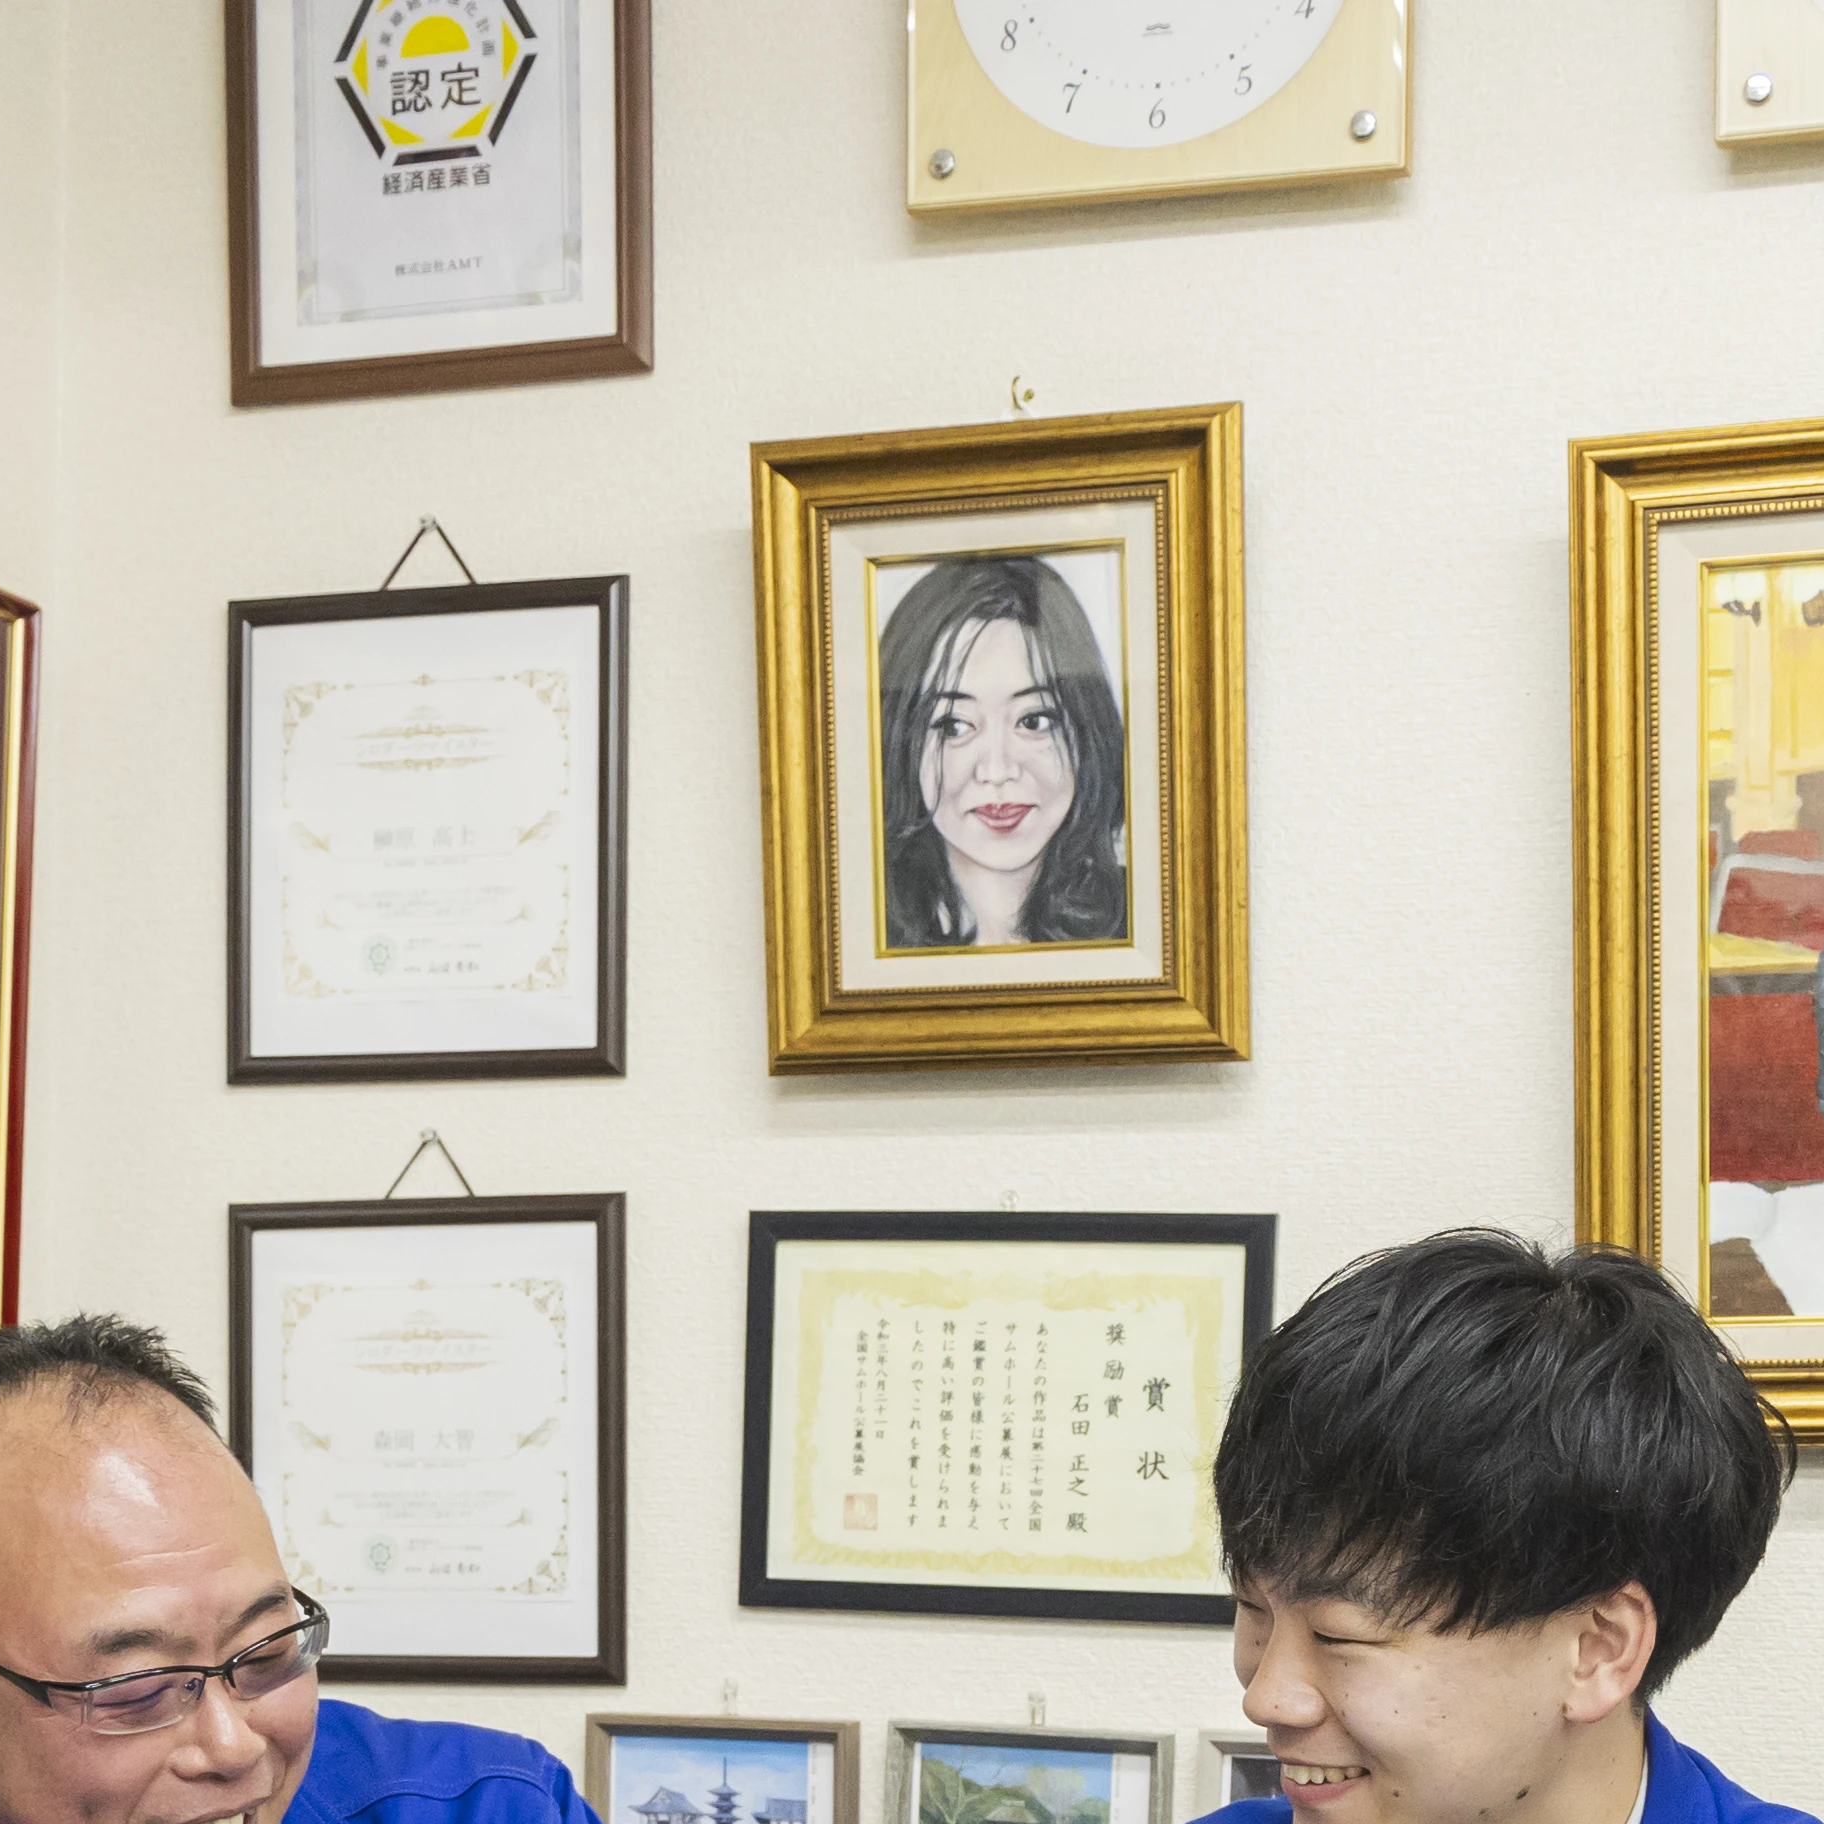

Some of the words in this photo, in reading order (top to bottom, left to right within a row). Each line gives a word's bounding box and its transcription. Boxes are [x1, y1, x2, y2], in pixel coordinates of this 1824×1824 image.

[1000, 20, 1018, 52] 8
[390, 62, 481, 116] 認定
[1062, 80, 1081, 114] 7
[1234, 64, 1253, 96] 5
[1149, 98, 1166, 129] 6
[382, 163, 492, 196] 経済産業省
[1103, 1323, 1125, 1419] 奨励賞
[907, 1320, 924, 1528] したのでこれを賞します
[938, 1321, 956, 1529] 特に高い評価を受けられま
[1071, 1393, 1090, 1436] 石田
[1136, 1377, 1171, 1480] 賞状
[1067, 1454, 1089, 1496] 正之
[1066, 1512, 1088, 1533] 殿
